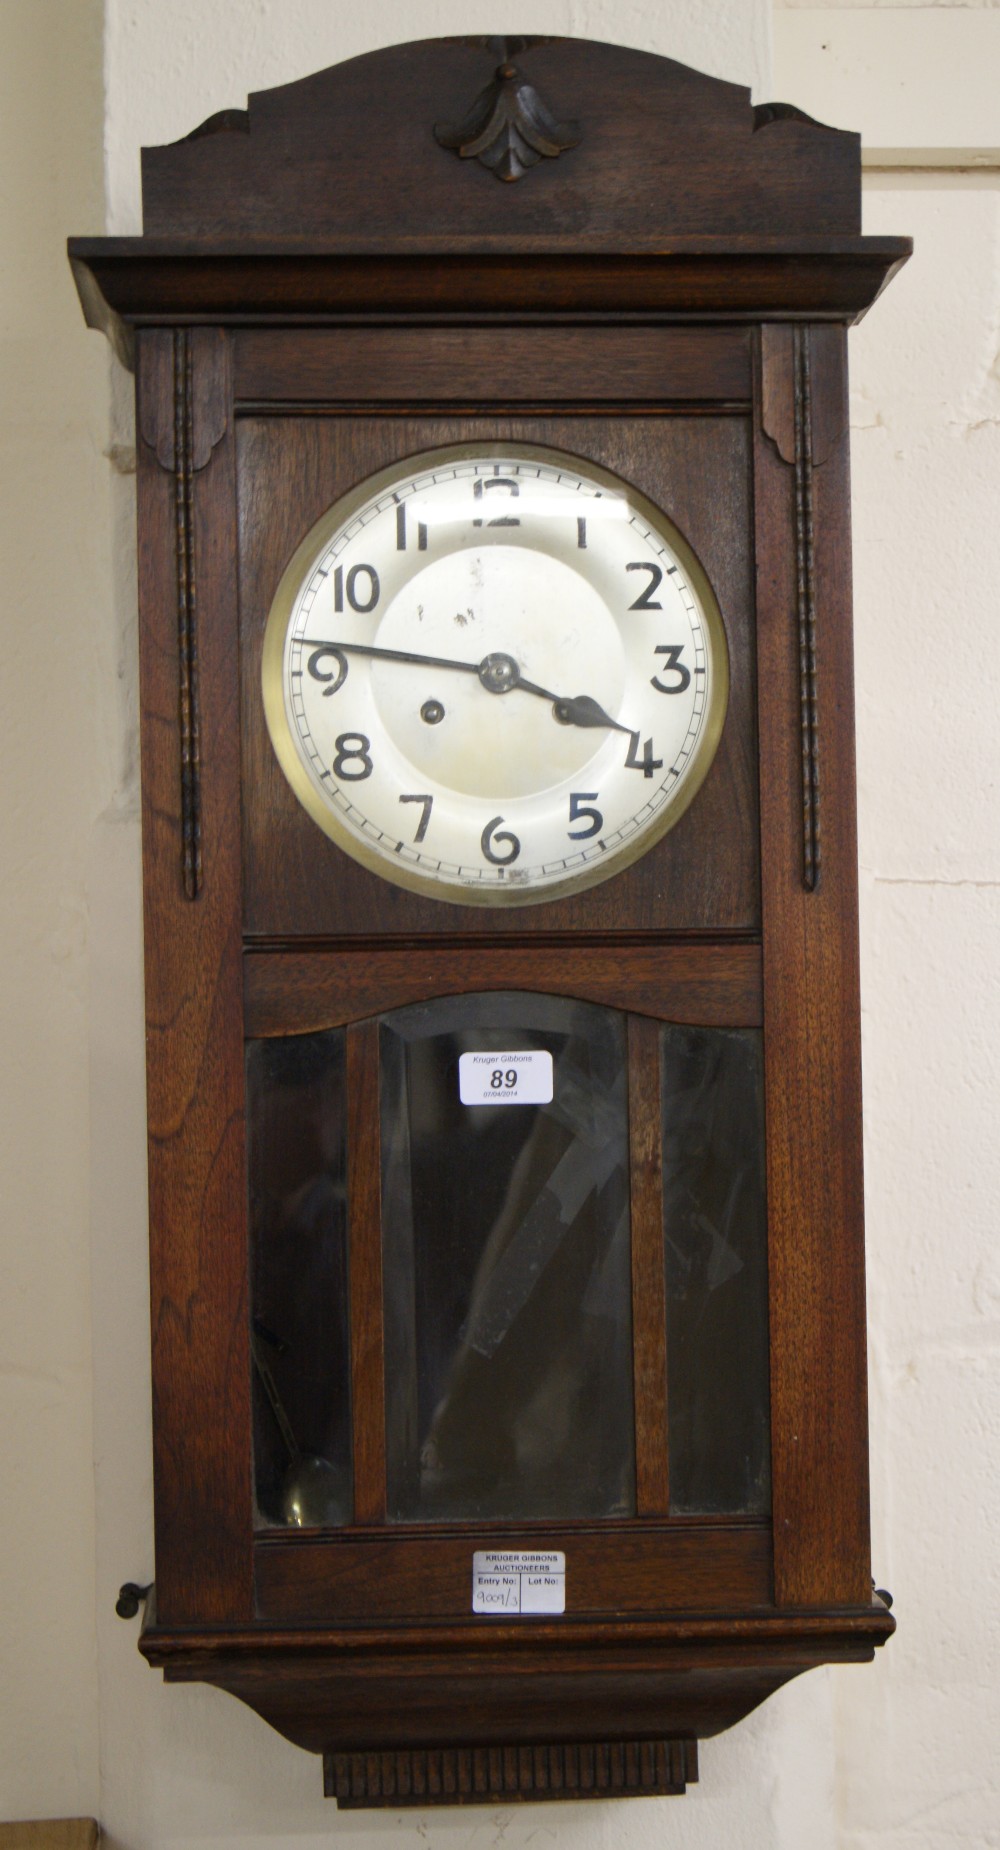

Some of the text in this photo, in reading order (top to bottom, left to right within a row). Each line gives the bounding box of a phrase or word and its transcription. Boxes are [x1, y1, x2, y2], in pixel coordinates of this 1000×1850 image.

[396, 502, 427, 551] 11
[472, 478, 520, 527] 12
[333, 563, 381, 613] 10
[625, 562, 663, 611] 2
[307, 646, 349, 697] 9
[650, 645, 691, 694] 3
[332, 733, 374, 781] 8
[624, 733, 663, 778] 4
[398, 794, 433, 843] 7
[480, 816, 521, 865] 6
[567, 792, 603, 840] 5
[473, 1055, 533, 1064] Kruger Gibbons
[490, 1069, 518, 1089] 89
[478, 1578, 500, 1586] Entry
